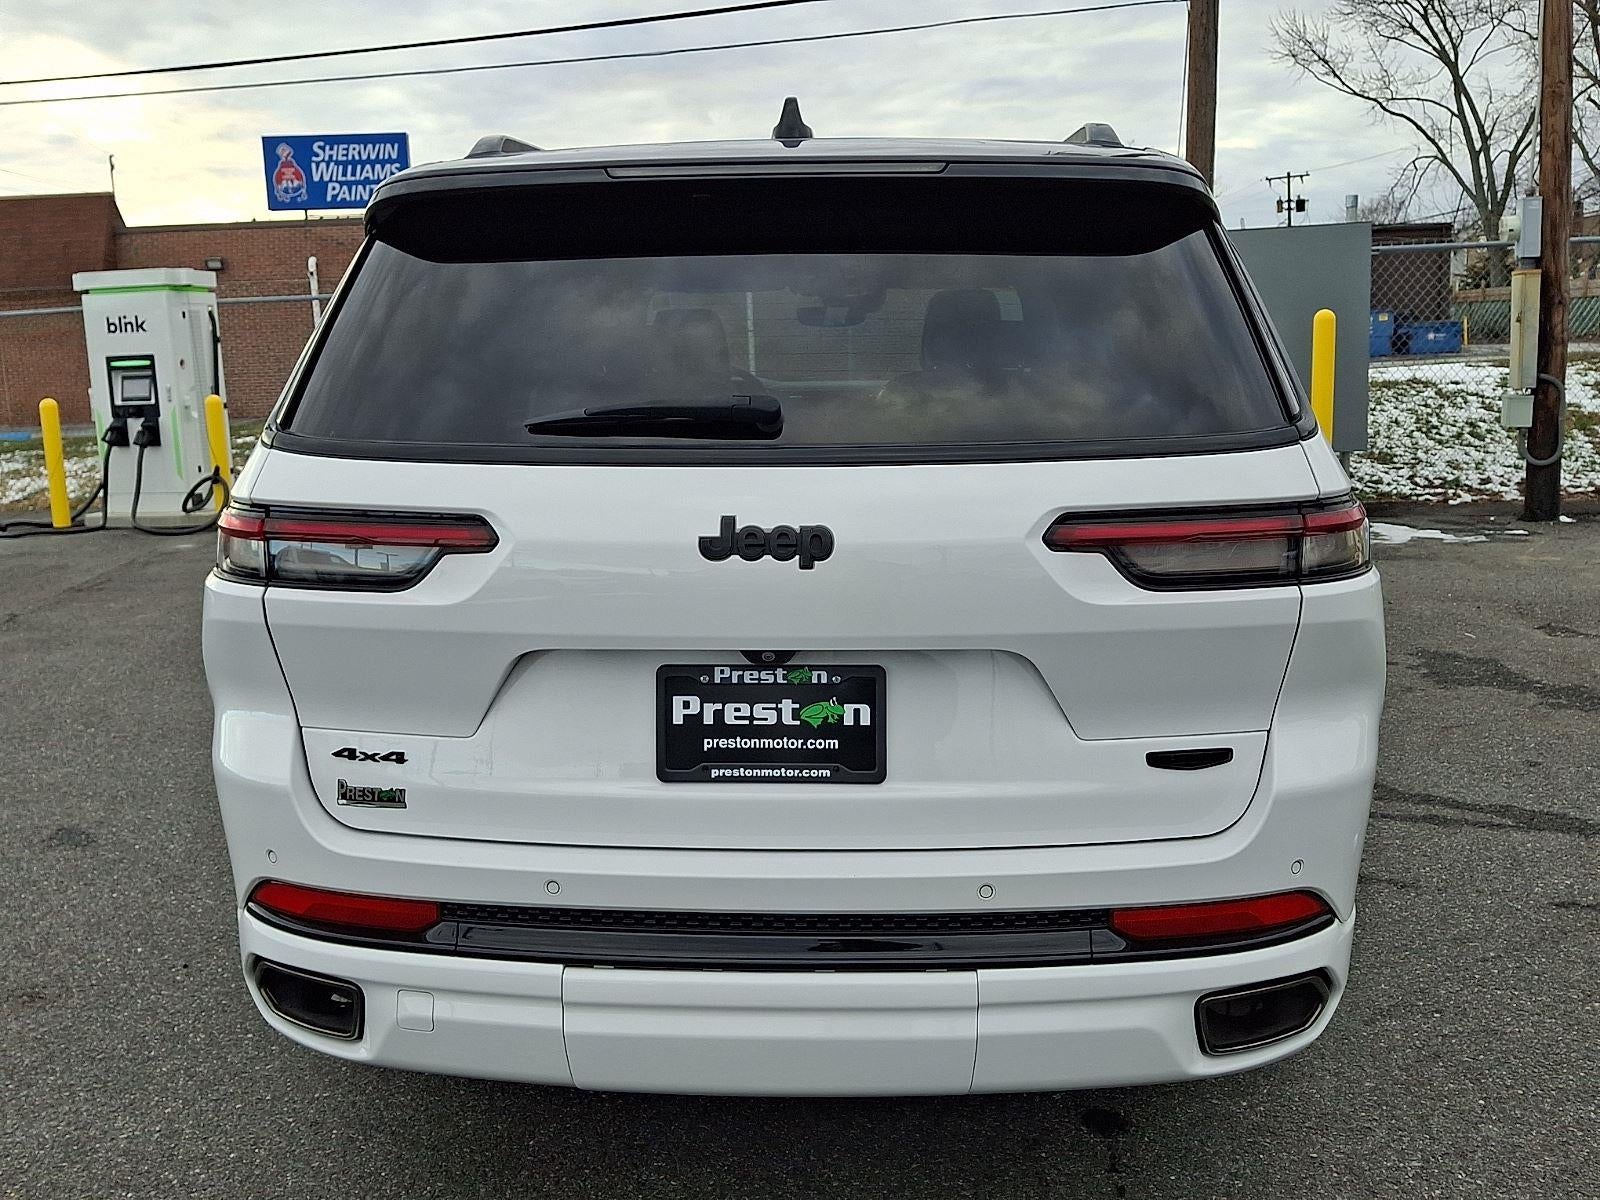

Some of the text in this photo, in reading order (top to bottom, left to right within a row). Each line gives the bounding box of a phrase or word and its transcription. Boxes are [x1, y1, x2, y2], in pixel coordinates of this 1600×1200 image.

[312, 141, 398, 161] SHERWIN
[311, 162, 400, 181] WILLIAMS
[106, 314, 147, 333] blink
[698, 515, 835, 570] Jeep
[713, 667, 828, 686] Prestn
[672, 695, 871, 727] Prestn
[703, 736, 839, 751] prestonmotor.com
[711, 766, 831, 778] prestonmotor.com
